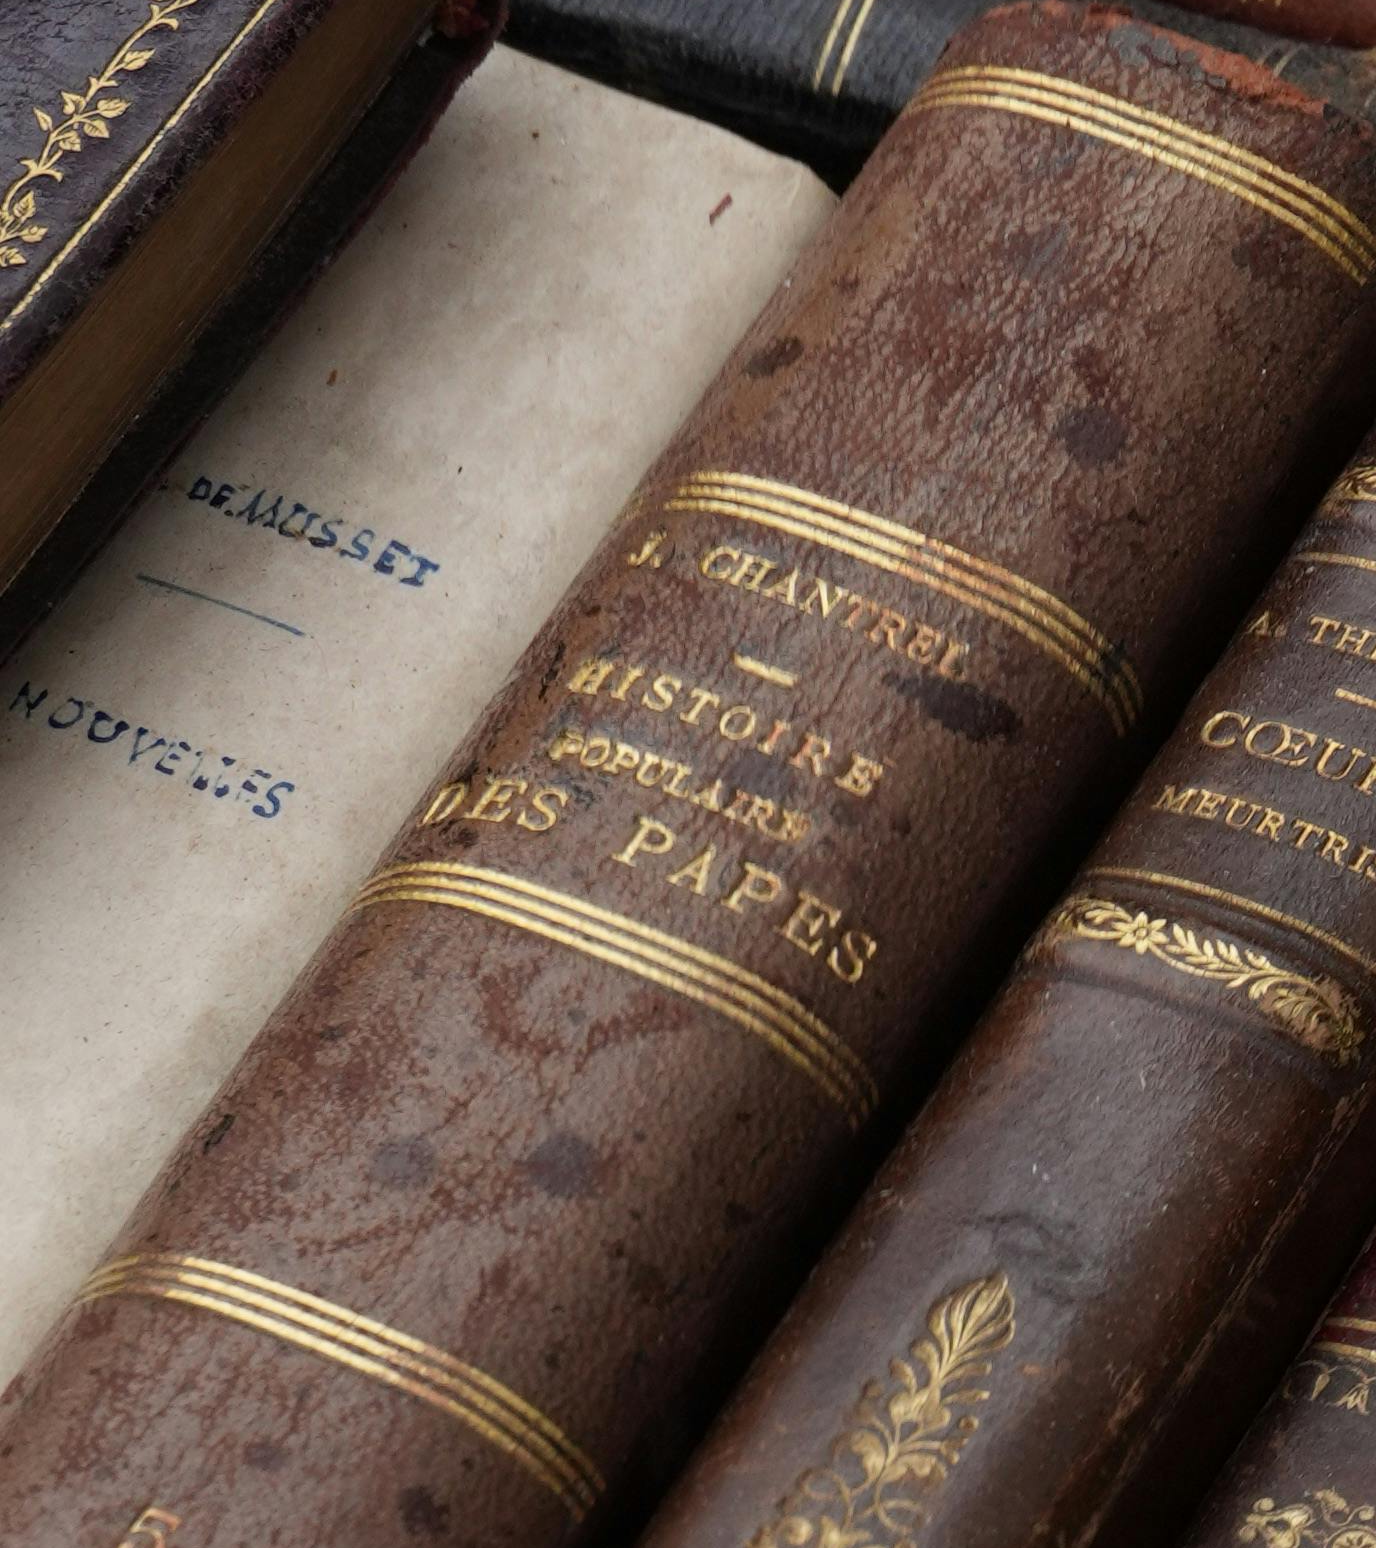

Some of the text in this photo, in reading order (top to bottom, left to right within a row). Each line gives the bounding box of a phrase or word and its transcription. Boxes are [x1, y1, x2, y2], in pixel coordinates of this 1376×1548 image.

[627, 529, 971, 678] J. CHANTREL
[547, 729, 813, 843] POPULAIRE
[566, 655, 885, 798] HISTOIRE
[416, 776, 881, 985] DES PAPES
